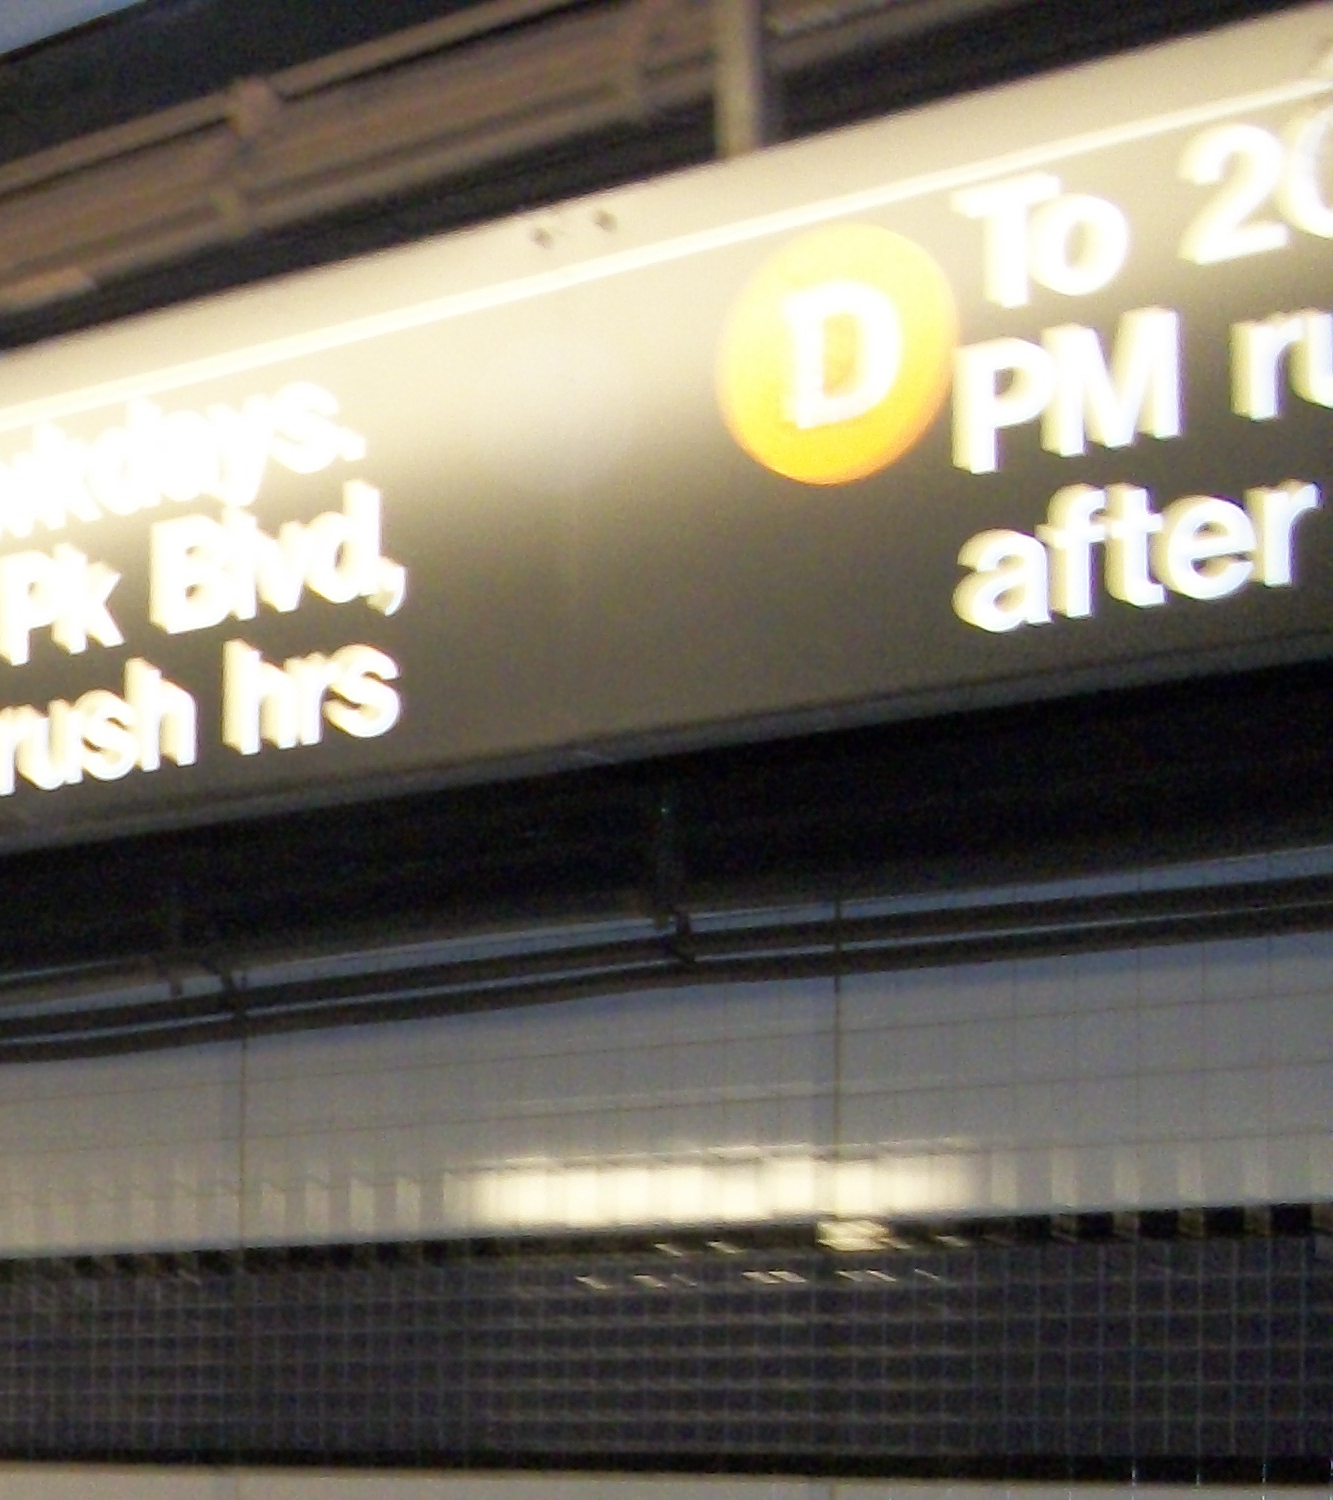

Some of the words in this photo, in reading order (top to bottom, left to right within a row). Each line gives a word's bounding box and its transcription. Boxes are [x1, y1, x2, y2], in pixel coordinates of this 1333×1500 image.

[955, 172, 1129, 308] To
[785, 280, 901, 430] D
[953, 306, 1181, 474] PM
[148, 480, 406, 635] Blvd,
[951, 480, 1321, 634] after
[222, 638, 403, 755] hrs
